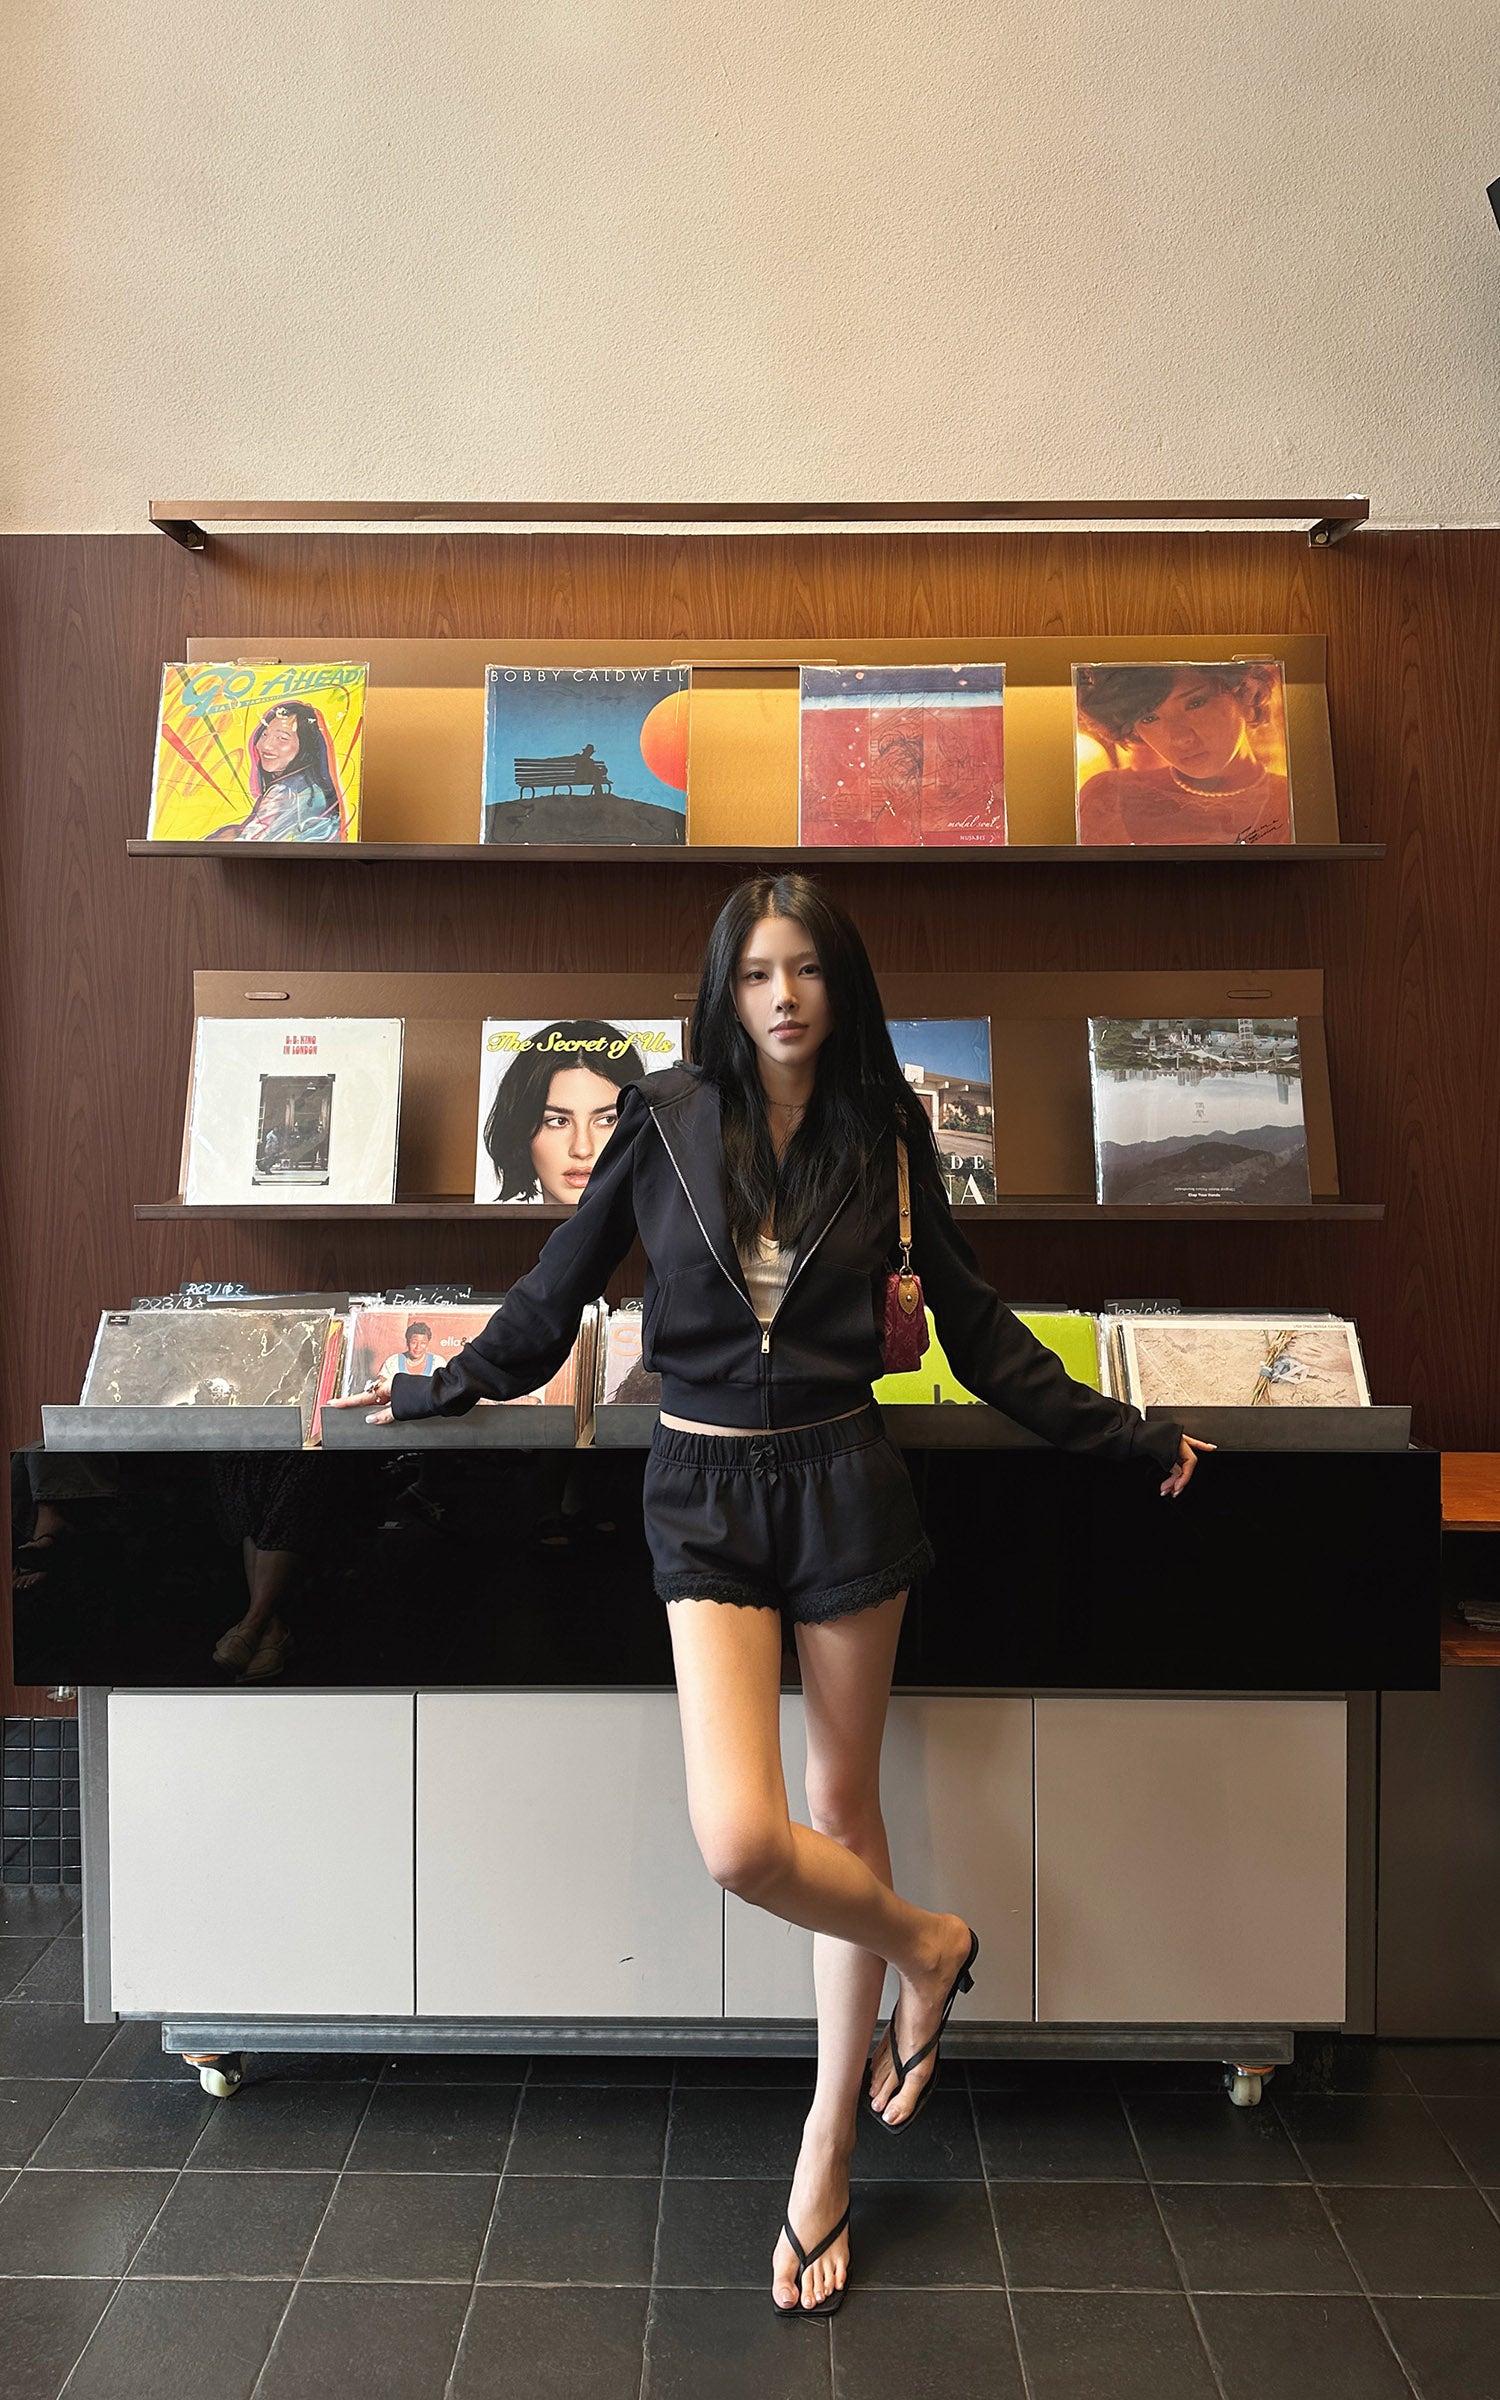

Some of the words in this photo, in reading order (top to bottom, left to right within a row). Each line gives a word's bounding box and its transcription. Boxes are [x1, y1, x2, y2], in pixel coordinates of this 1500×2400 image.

[490, 670, 560, 682] BOBBY
[572, 670, 684, 682] CALDWELL
[292, 1045, 318, 1055] LONDON
[487, 1031, 535, 1053] The
[536, 1031, 609, 1052] Secret
[606, 1031, 640, 1060] of
[638, 1031, 676, 1053] Us
